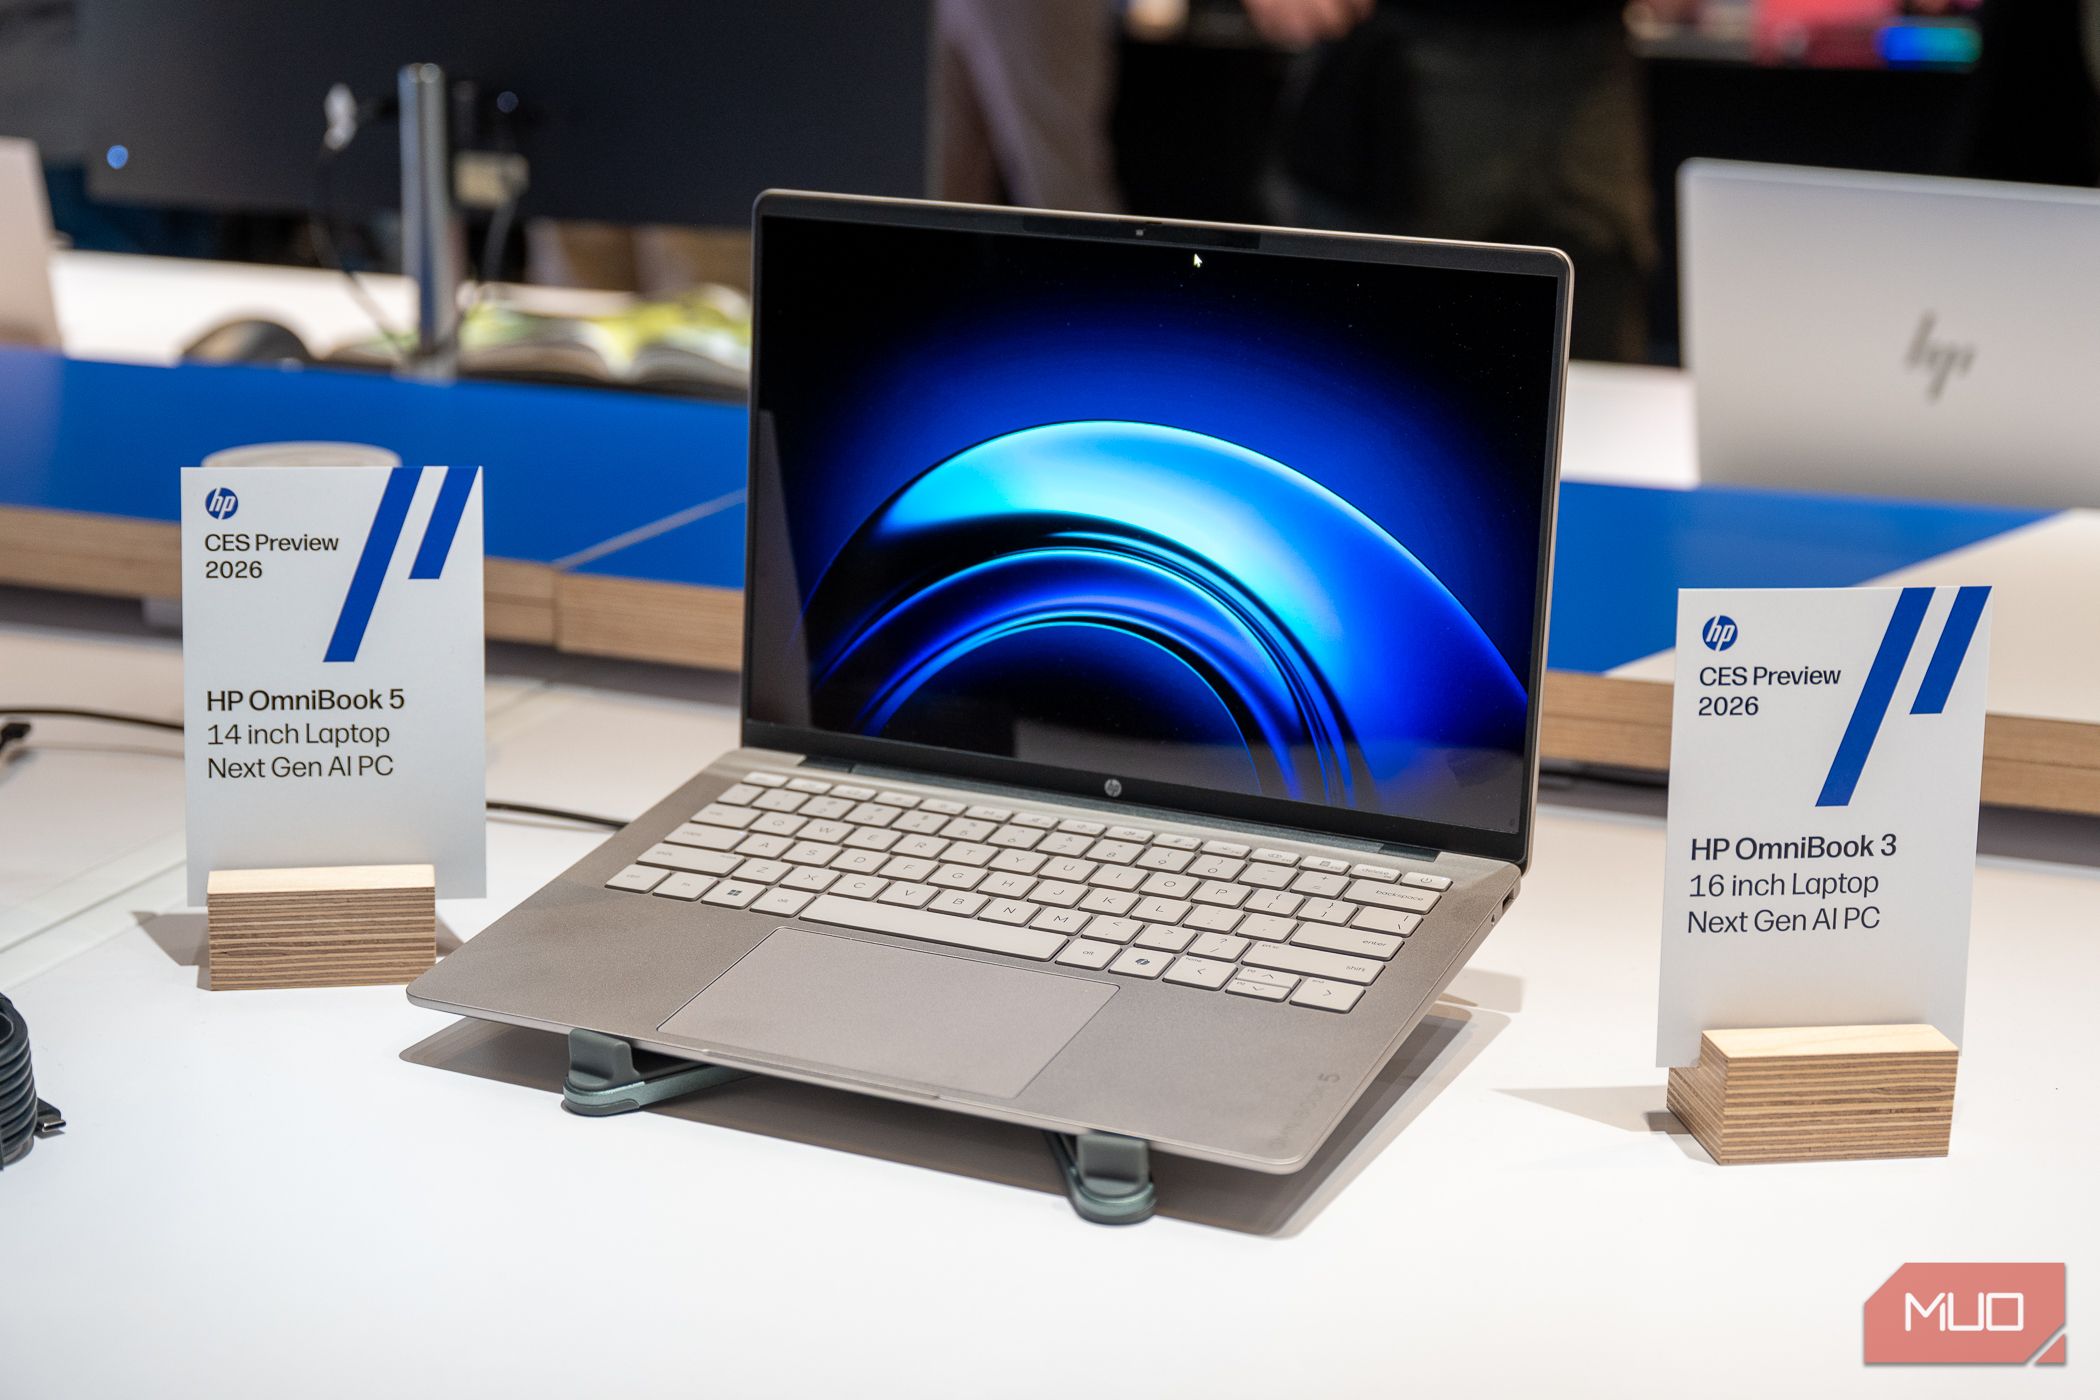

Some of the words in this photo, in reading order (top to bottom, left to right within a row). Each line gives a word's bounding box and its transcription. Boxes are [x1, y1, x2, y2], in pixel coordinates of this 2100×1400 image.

[205, 487, 239, 520] hp
[205, 534, 250, 551] CES
[256, 534, 338, 551] Preview
[206, 561, 262, 578] 2026
[1702, 615, 1739, 652] hp
[1700, 667, 1747, 686] CES
[1753, 666, 1841, 685] Preview
[208, 691, 243, 711] HP
[249, 689, 382, 711] OmniBook
[390, 689, 404, 709] 5
[1699, 696, 1758, 716] 2026
[208, 724, 241, 745] 14
[248, 723, 298, 744] inch
[306, 723, 390, 748] Laptop
[209, 758, 265, 778] Next
[272, 757, 322, 777] Gen
[328, 756, 351, 776] AI
[359, 755, 393, 776] PC
[1692, 838, 1730, 860] HP
[1736, 835, 1874, 860] OmniBook
[1881, 834, 1896, 856] 3
[1015, 855, 1025, 864] Y
[1062, 864, 1076, 873] U
[951, 872, 964, 880] G
[853, 881, 867, 889] C
[1001, 880, 1015, 888] H
[1690, 874, 1724, 897] 16
[1732, 873, 1785, 896] inch
[1792, 873, 1878, 899] Laptop
[904, 889, 918, 897] V
[1052, 888, 1065, 896] J
[1215, 888, 1228, 896] P
[952, 897, 965, 905] B
[1101, 896, 1116, 905] K
[1003, 906, 1018, 914] N
[1155, 905, 1165, 913] L
[1052, 915, 1069, 923] M
[1688, 911, 1748, 933] Next
[1754, 910, 1806, 932] Gen
[1812, 908, 1837, 930] AI
[1844, 906, 1880, 929] PC
[1362, 938, 1388, 947] enter
